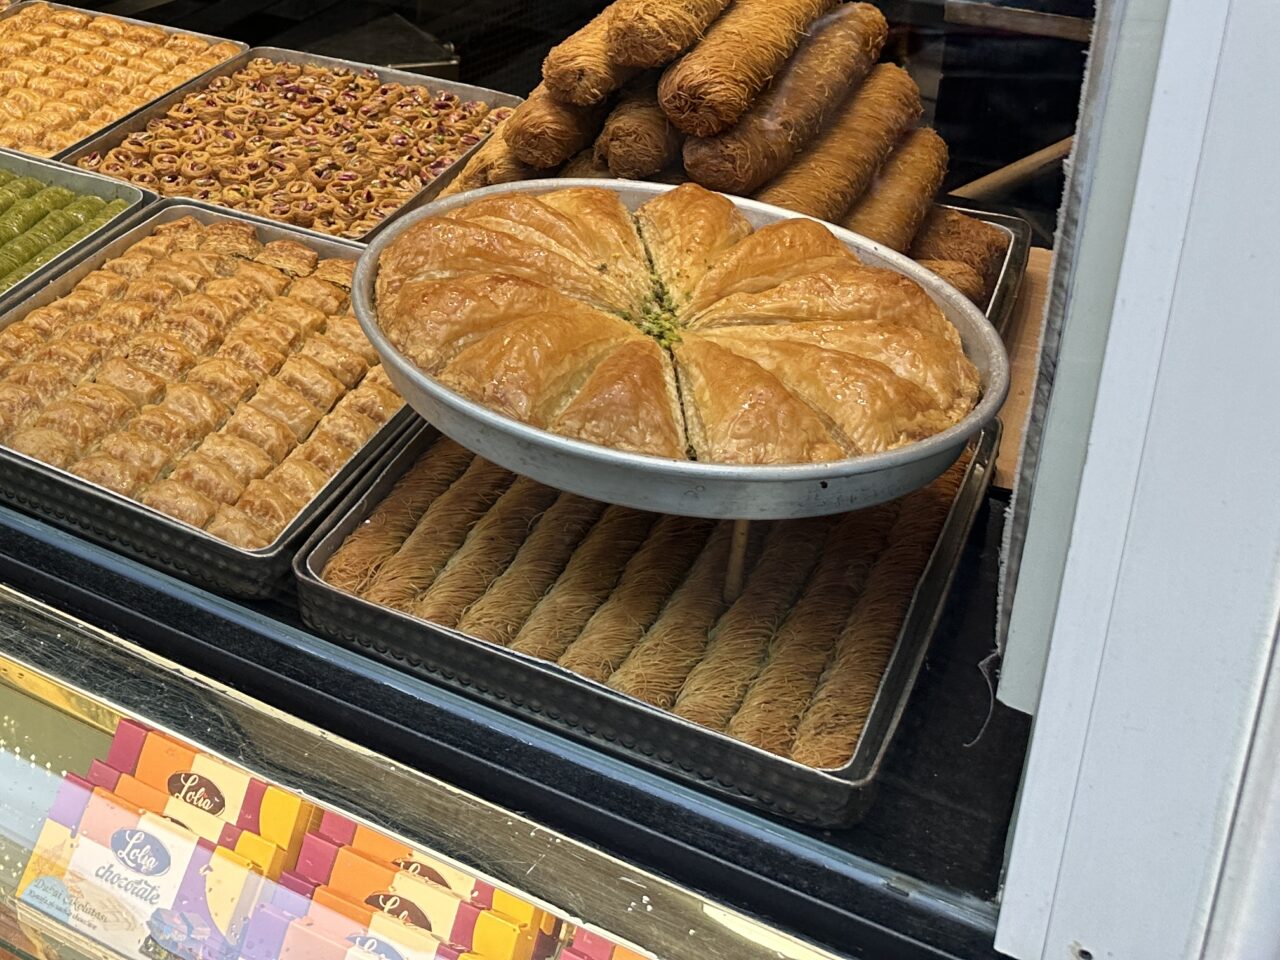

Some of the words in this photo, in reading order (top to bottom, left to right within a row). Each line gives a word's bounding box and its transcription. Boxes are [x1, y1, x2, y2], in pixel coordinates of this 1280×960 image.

[174, 773, 214, 811] Lolia
[117, 829, 159, 872] Lolia
[95, 863, 161, 905] chocolate
